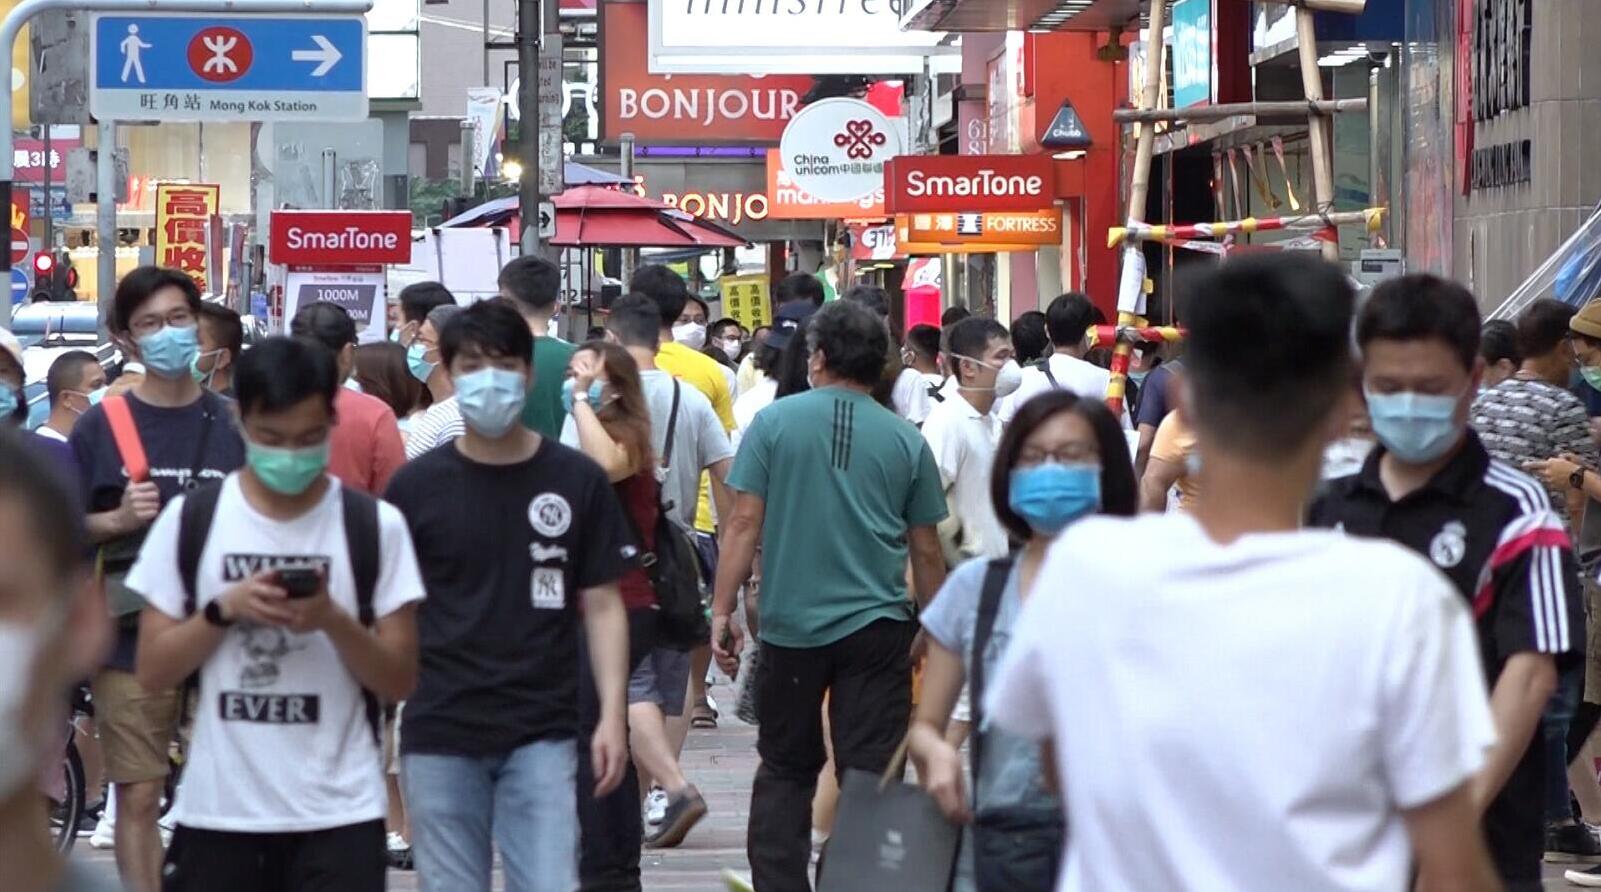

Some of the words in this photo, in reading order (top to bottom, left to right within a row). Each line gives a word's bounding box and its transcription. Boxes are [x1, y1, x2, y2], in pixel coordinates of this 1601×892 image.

[140, 93, 200, 110] 旺角站
[210, 100, 245, 114] Mong
[249, 100, 271, 111] Kok
[274, 100, 317, 112] Station
[619, 88, 799, 126] BONJOUR
[1052, 128, 1082, 138] Chubb
[794, 153, 830, 165] China
[795, 164, 840, 175] unicom
[906, 169, 1042, 196] SmarTone
[986, 215, 1057, 232] FORTRESS
[286, 226, 398, 249] SmarTone
[317, 289, 360, 301] 1000M
[225, 693, 309, 722] EVER
